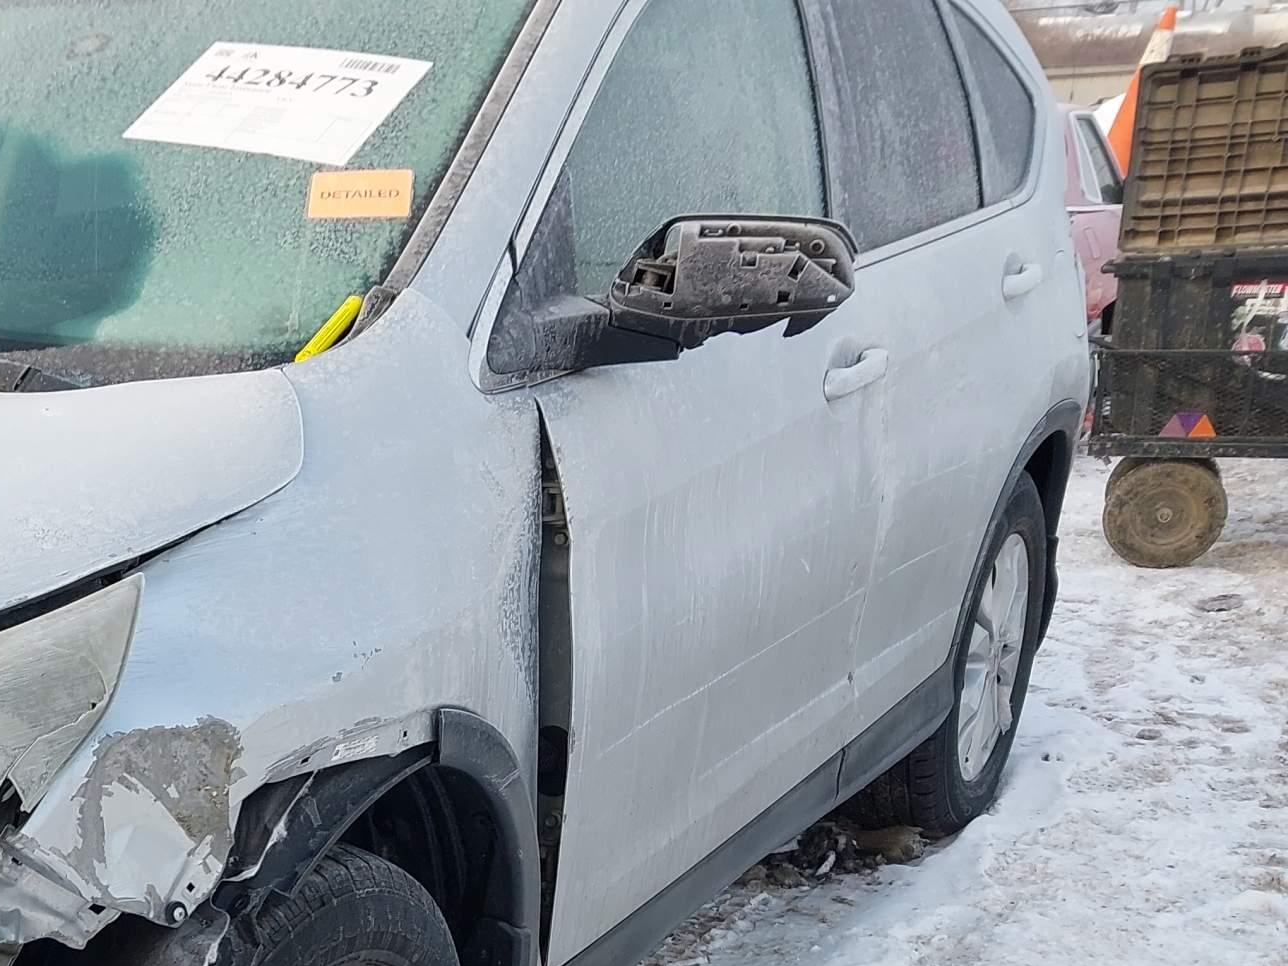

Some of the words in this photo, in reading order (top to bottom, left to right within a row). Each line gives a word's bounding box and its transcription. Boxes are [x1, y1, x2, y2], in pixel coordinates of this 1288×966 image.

[205, 65, 379, 97] 44284773
[319, 188, 401, 200] DETAILED
[1231, 284, 1283, 297] FLOWMTER
